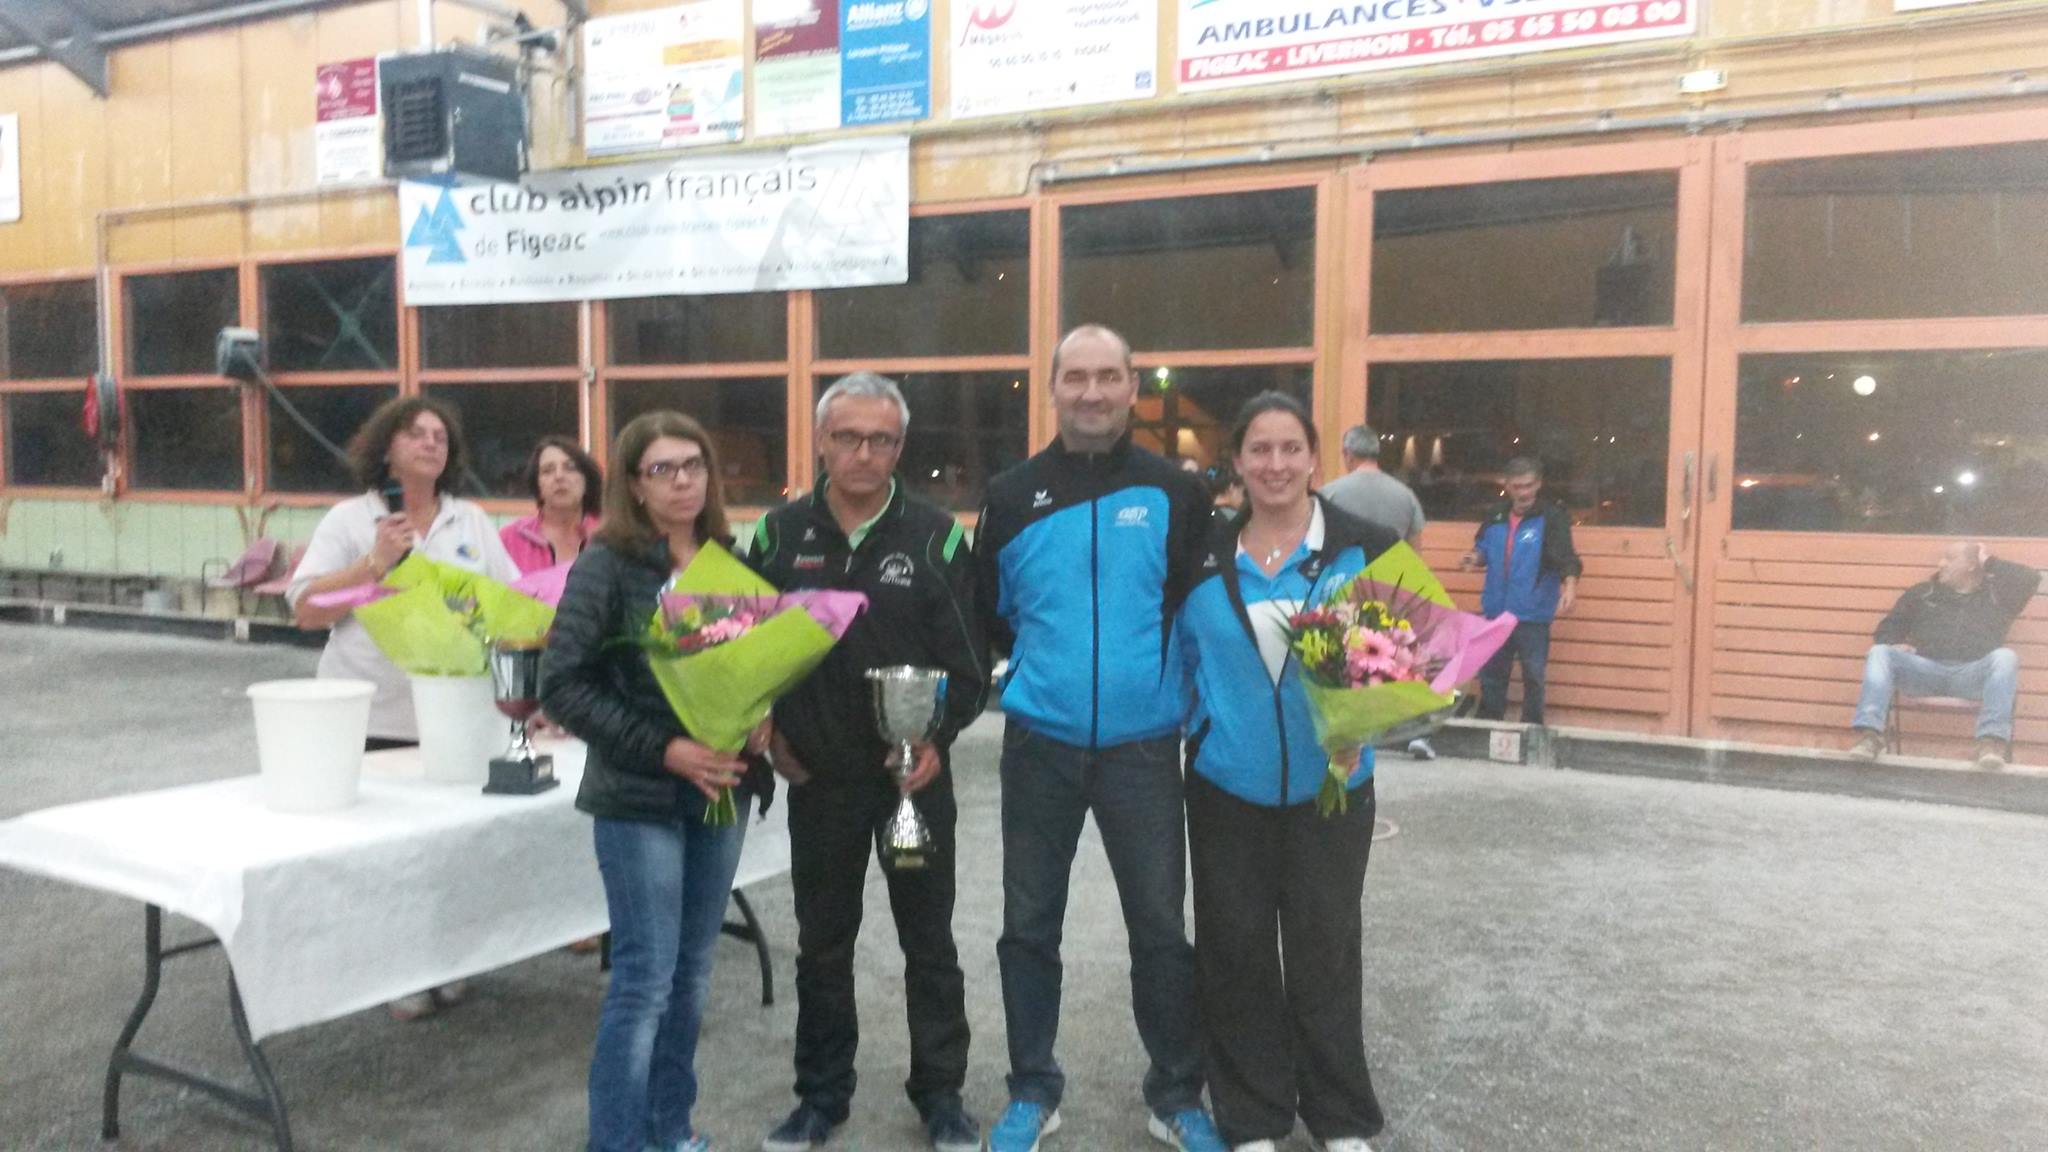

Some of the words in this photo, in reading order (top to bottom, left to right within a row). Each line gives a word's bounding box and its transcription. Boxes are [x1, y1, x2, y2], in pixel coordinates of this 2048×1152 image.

[1197, 0, 1447, 46] AMBULANCES
[1188, 52, 1270, 79] FIGEAC
[1286, 33, 1409, 67] LIVERNON
[470, 182, 549, 215] club
[559, 175, 651, 215] alpin
[664, 160, 819, 207] français
[474, 233, 499, 257] de
[506, 229, 587, 260] Figeac
